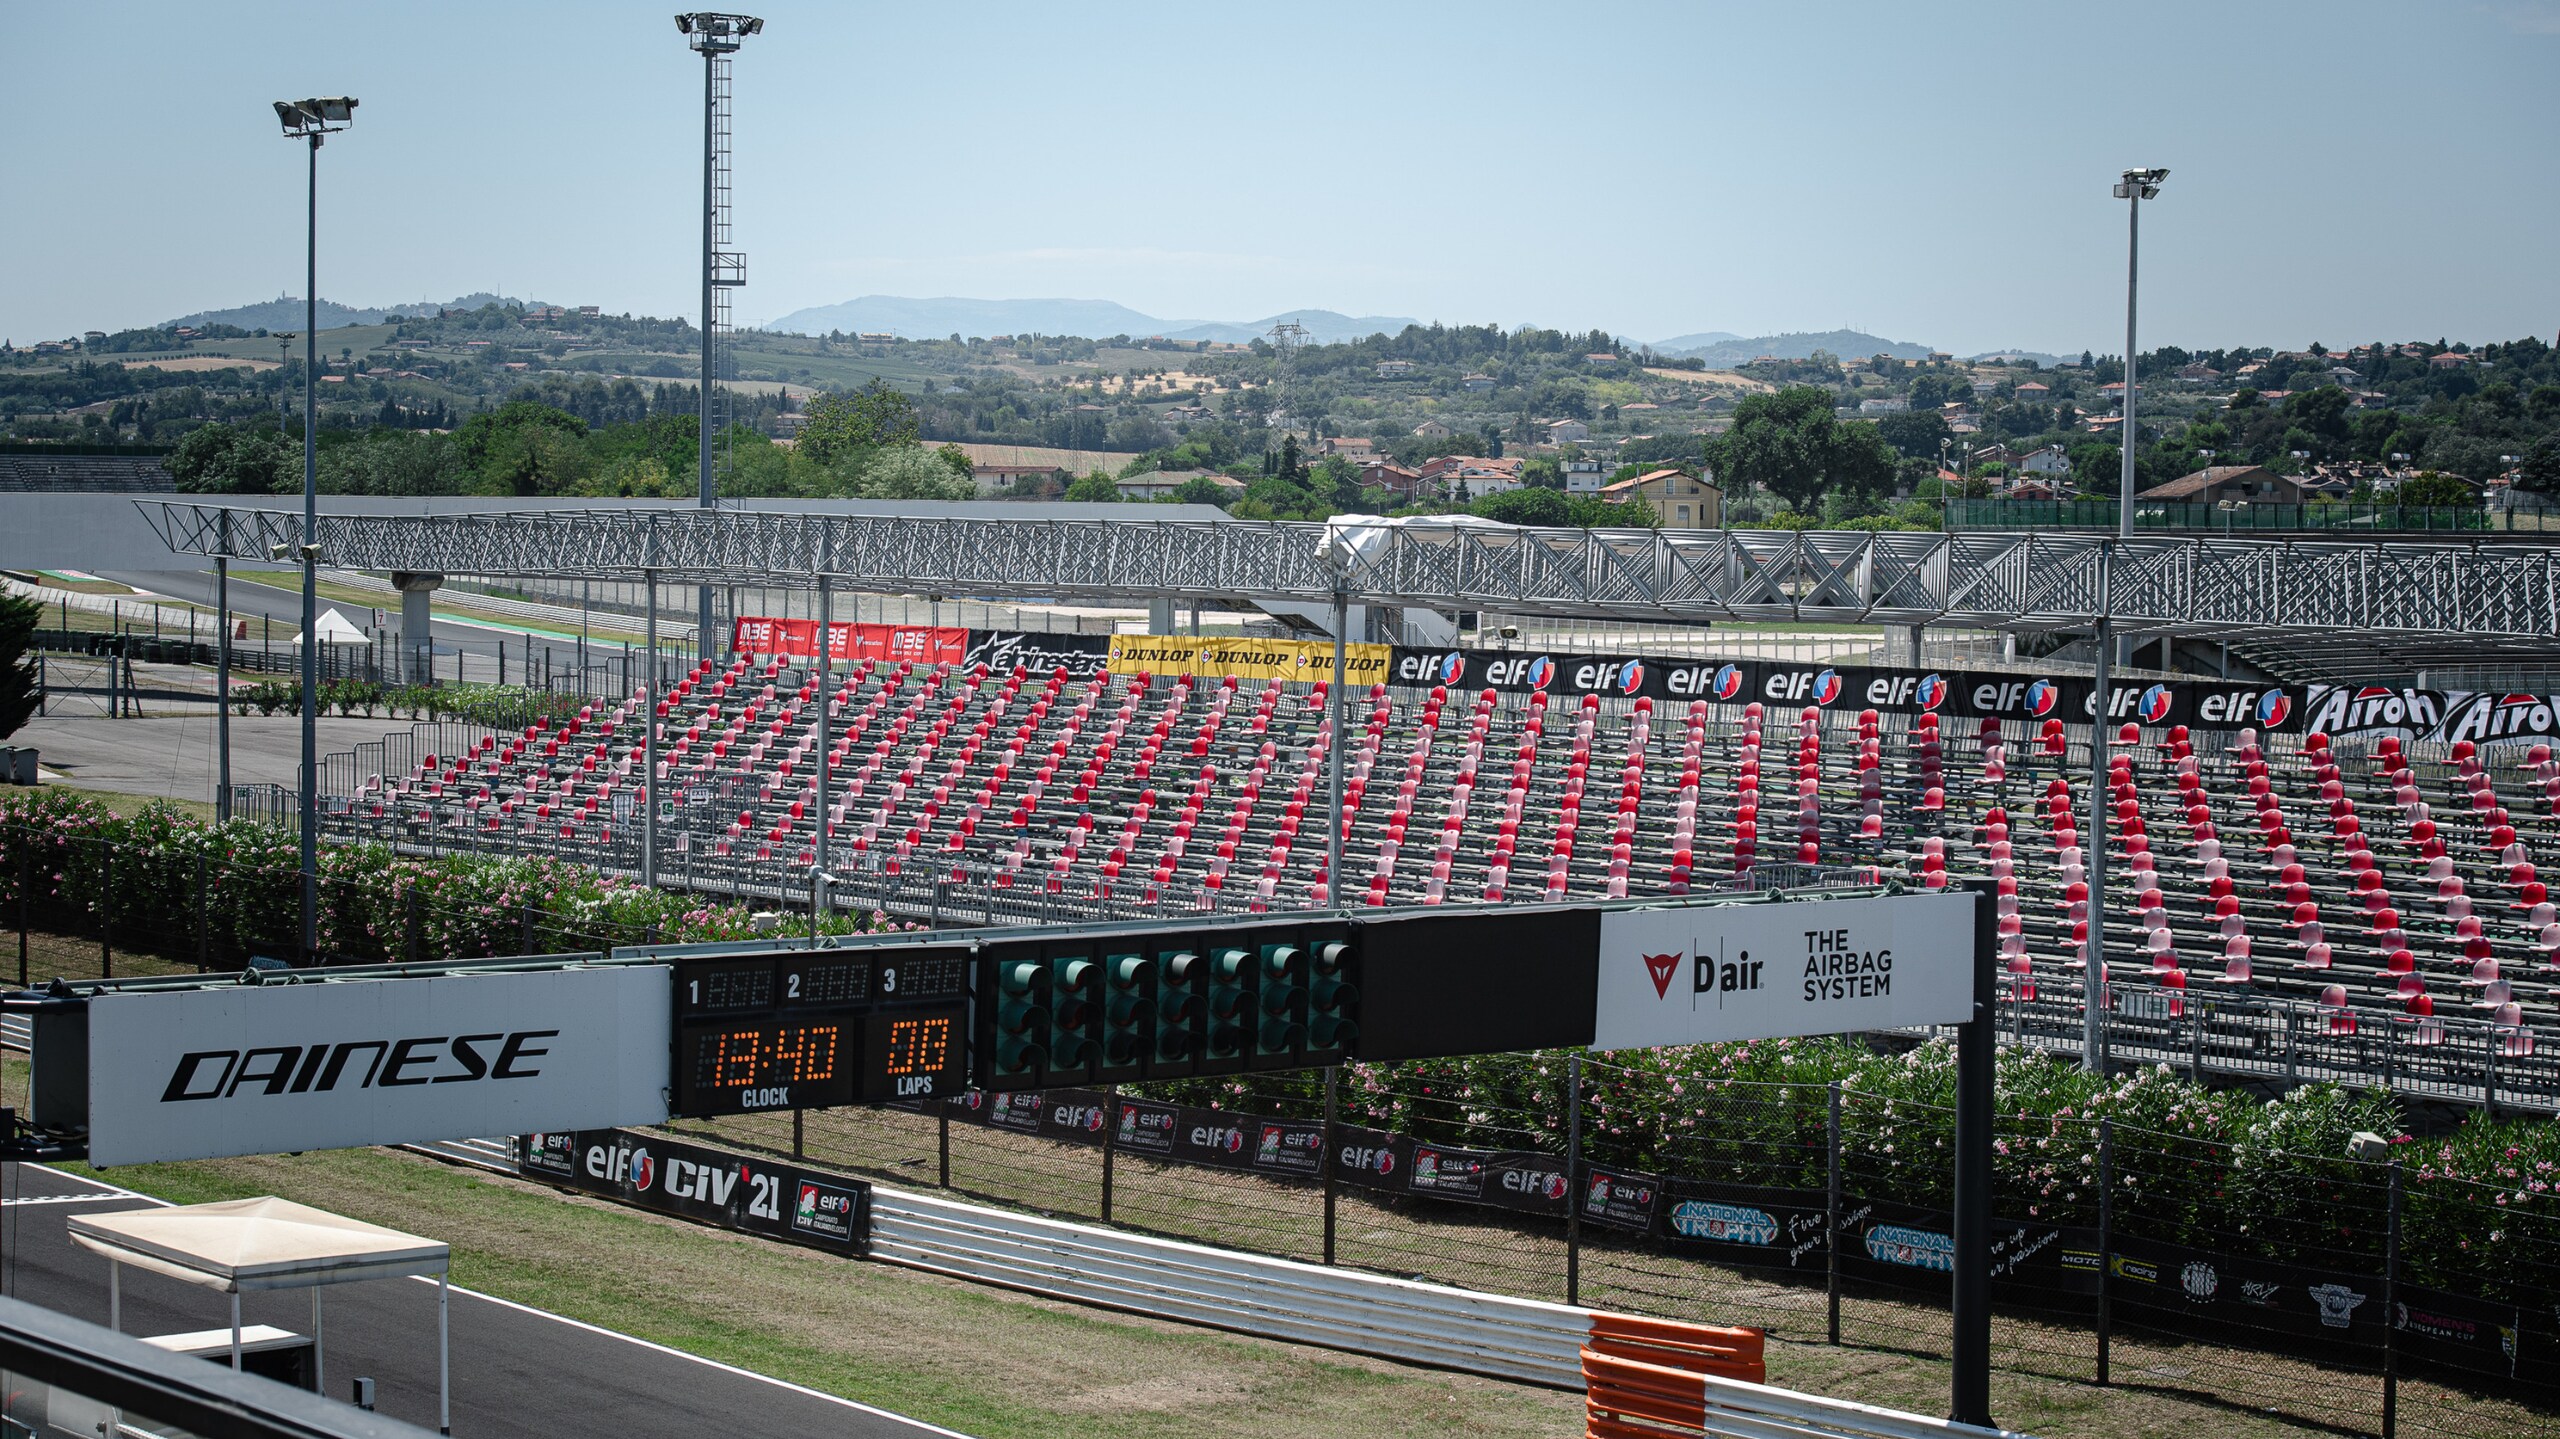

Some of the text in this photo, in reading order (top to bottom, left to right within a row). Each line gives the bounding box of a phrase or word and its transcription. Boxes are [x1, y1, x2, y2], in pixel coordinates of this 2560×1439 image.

[1125, 649, 1194, 661] DUNLOP
[1214, 651, 1288, 666] DUNLOP
[1399, 655, 1442, 681] elf
[1486, 659, 1529, 685] elf
[1575, 663, 1620, 689] elf
[1667, 667, 1714, 694] elf
[1765, 672, 1813, 700] elf
[1866, 677, 1916, 704] elf
[1973, 682, 2025, 711] elf
[2084, 688, 2139, 717] elf
[2200, 692, 2254, 722] elf
[2309, 688, 2438, 737] Airoh
[2450, 697, 2560, 745] Airo
[1803, 929, 1848, 953] THE
[1803, 949, 1892, 978] AIRBAG
[689, 980, 699, 1005] 1
[787, 973, 800, 999] 2
[883, 968, 896, 992] 3
[1803, 973, 1890, 1001] SYSTEM
[159, 1029, 560, 1103] DAINESE
[713, 1026, 838, 1087] 13:40
[742, 1086, 789, 1108] CLOCK
[897, 1075, 933, 1096] LAPS
[1054, 1106, 1086, 1128] elf
[547, 1135, 563, 1149] elf
[1190, 1126, 1225, 1148] elf
[586, 1145, 630, 1182] elf
[1340, 1146, 1374, 1169] elf
[1502, 1170, 1544, 1194] elf
[820, 1195, 839, 1210] elf
[1686, 1203, 1767, 1226] NATIONAL
[2410, 1311, 2476, 1333] WOMEN'S
[2456, 1332, 2475, 1340] CUP
